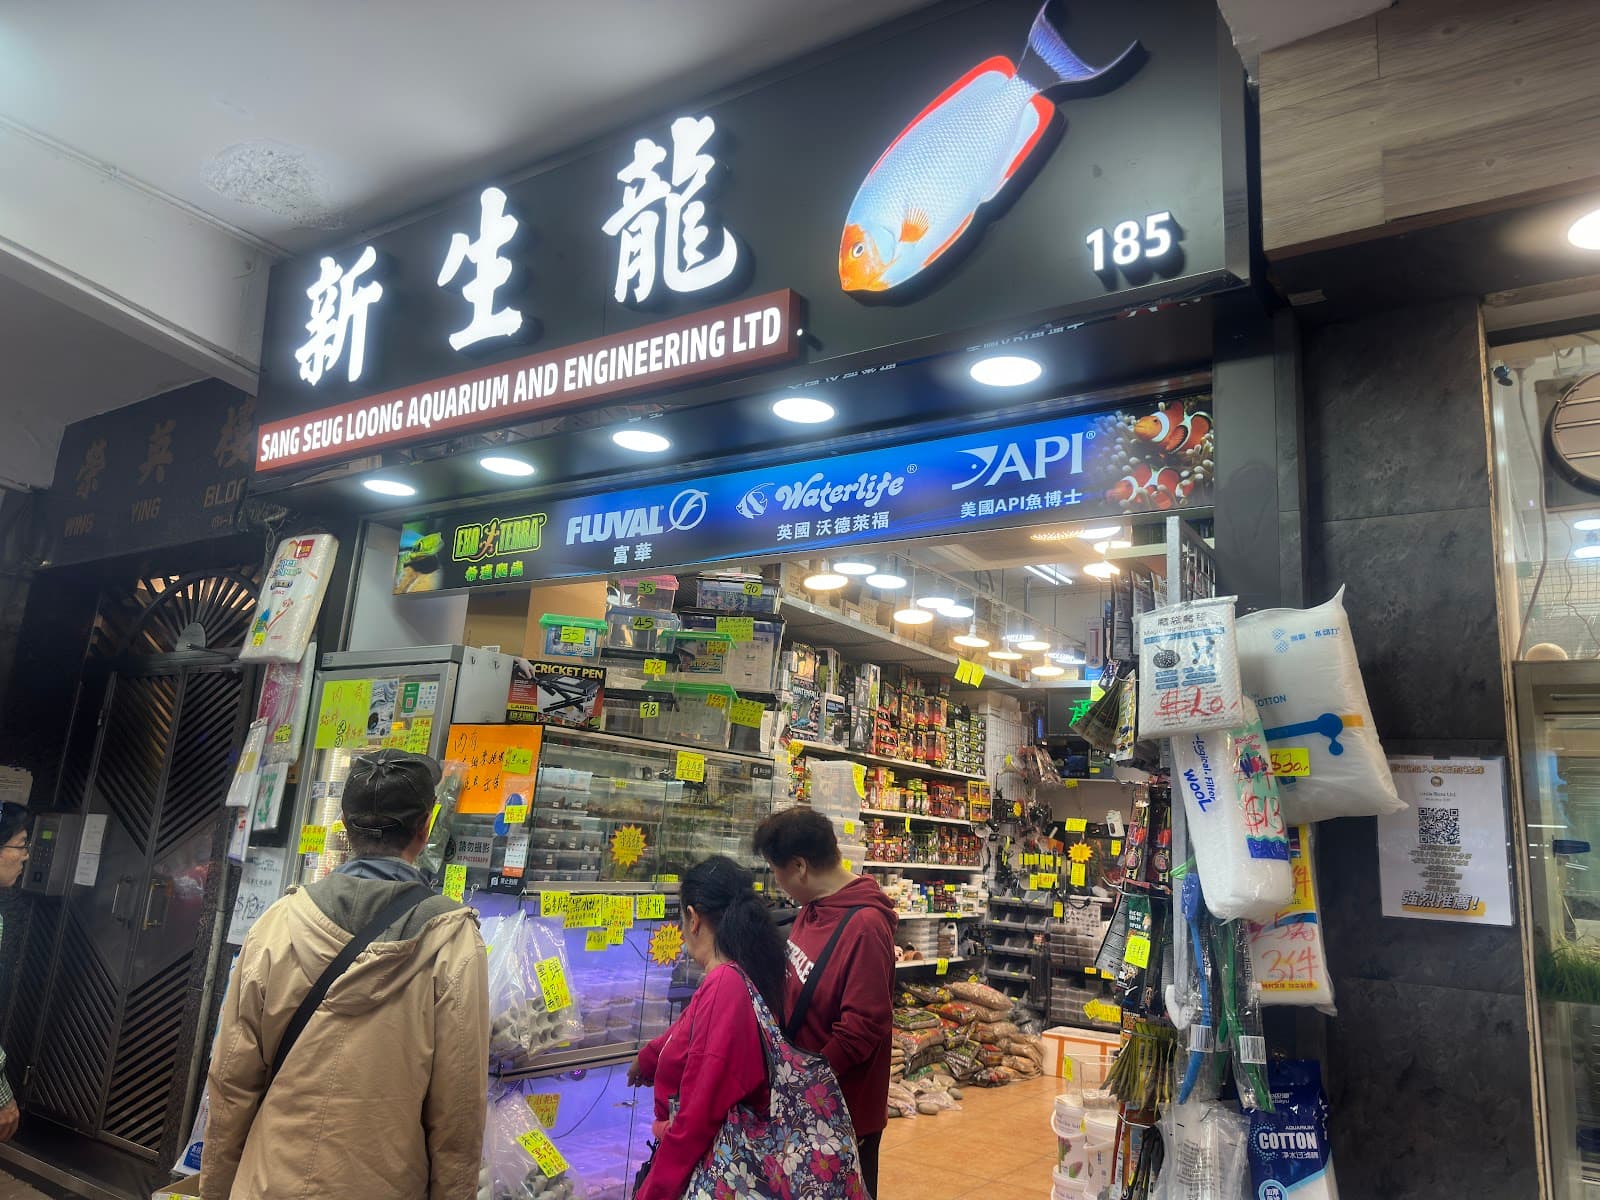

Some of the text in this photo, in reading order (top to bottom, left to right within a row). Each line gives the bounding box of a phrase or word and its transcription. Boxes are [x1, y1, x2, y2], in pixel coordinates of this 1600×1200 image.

[294, 115, 738, 386] 新生龍
[1086, 211, 1172, 271] 185
[259, 306, 781, 462] SANG SEUG LOONG AQUARIUM AND ENGINEERING LTD
[984, 432, 1085, 488] API
[775, 470, 905, 513] Waterlife
[960, 488, 1083, 519] 美國API魚博士
[566, 507, 665, 545] FLUVAL
[776, 511, 890, 541] 英國 沃德萊福
[613, 542, 653, 565] 富華
[639, 583, 654, 594] 35
[744, 584, 759, 594] 90
[634, 617, 654, 629] 45
[533, 663, 604, 680] CRICKET PEN
[642, 703, 657, 716] 98
[1184, 768, 1212, 812] WOOL
[1258, 1132, 1318, 1149] COTTON
